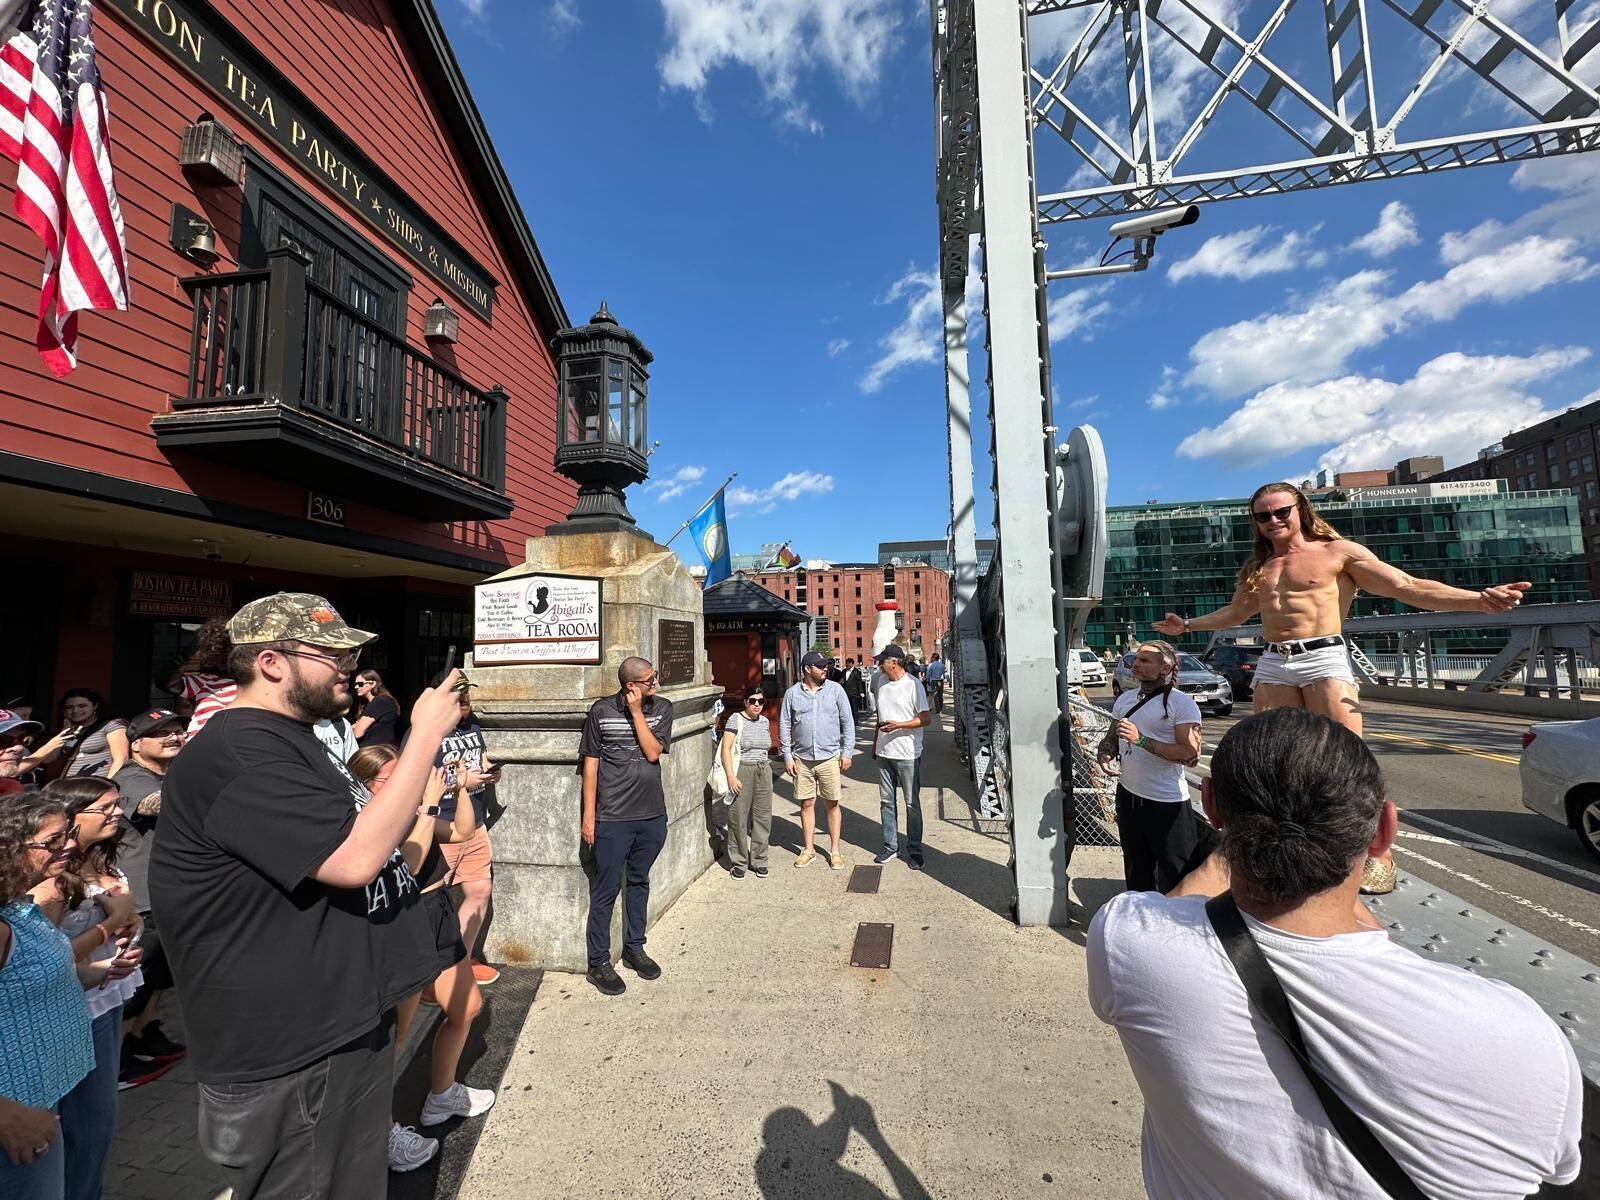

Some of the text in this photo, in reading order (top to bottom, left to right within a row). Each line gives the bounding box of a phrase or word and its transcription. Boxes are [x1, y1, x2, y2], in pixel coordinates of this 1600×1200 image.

[221, 56, 278, 130] TEA
[291, 118, 366, 202] PARTY
[387, 208, 423, 252] SHIPS
[428, 245, 439, 267] &
[443, 257, 487, 309] MUSEUM
[1366, 487, 1418, 497] HUNNEMAN
[1440, 481, 1491, 489] 617.457.3400
[312, 497, 342, 520] 306
[134, 575, 231, 597] BOSTON TEA PARTY
[551, 603, 594, 617] Abigail's
[526, 622, 598, 637] TEA ROOM
